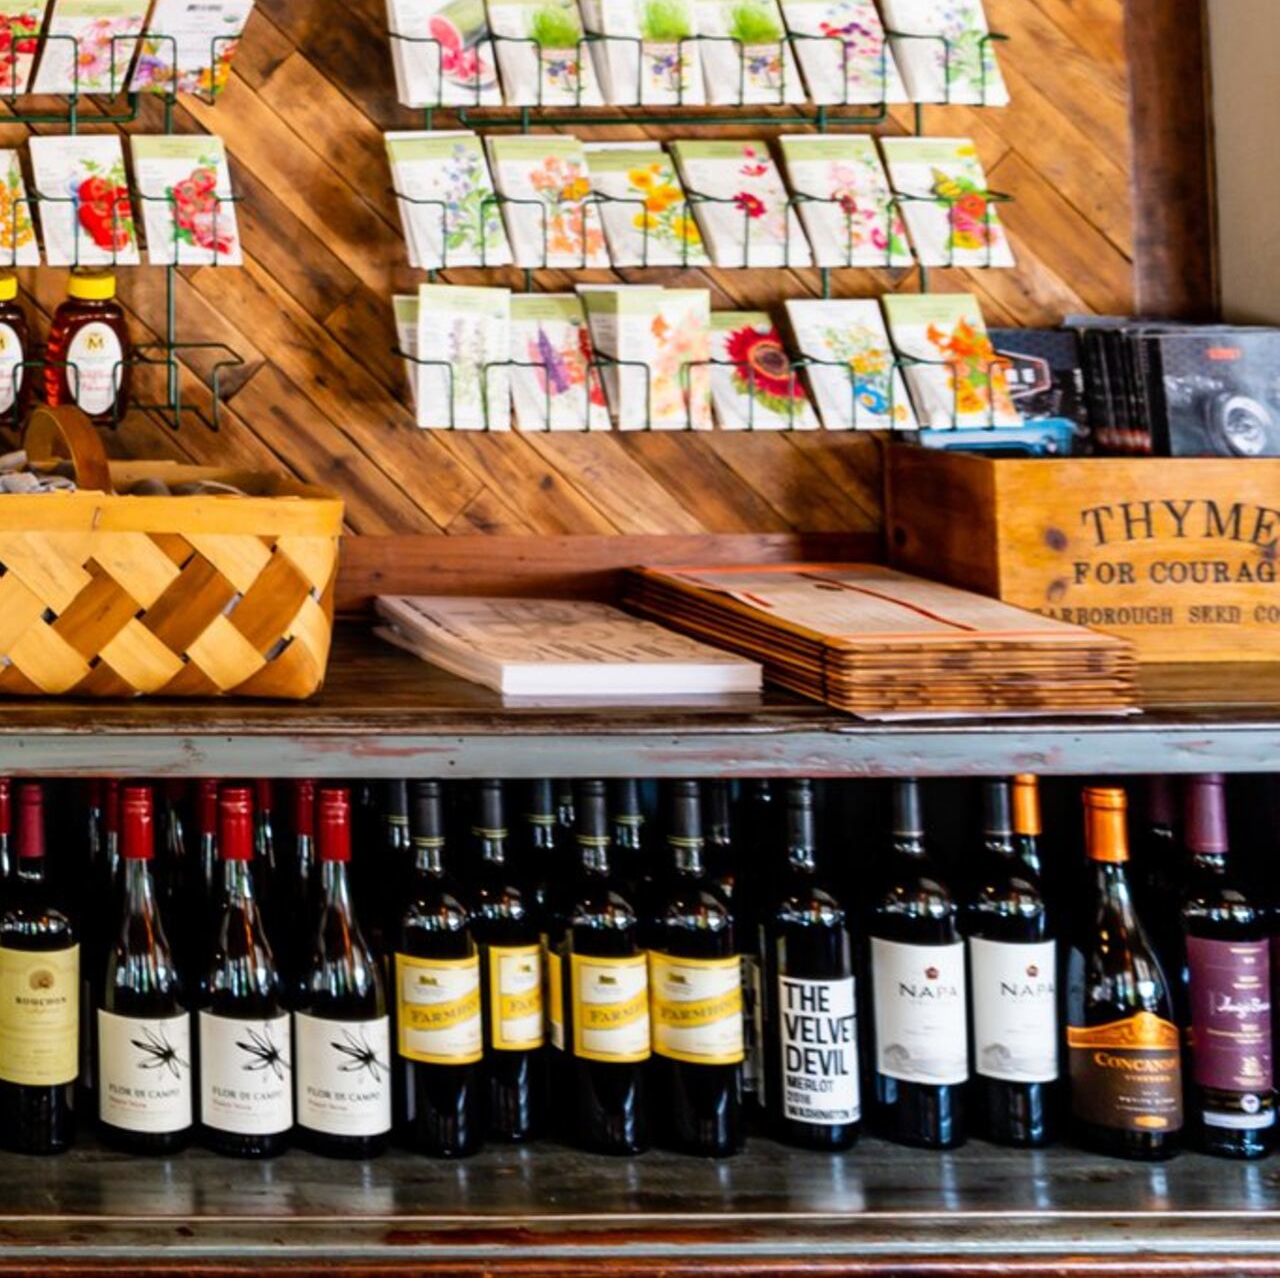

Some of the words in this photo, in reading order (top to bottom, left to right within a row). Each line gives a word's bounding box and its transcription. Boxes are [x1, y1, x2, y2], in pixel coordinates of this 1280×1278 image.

[1081, 499, 1280, 549] THYME
[1073, 562, 1136, 584] FOR
[1149, 561, 1276, 584] COURAG
[1038, 607, 1173, 625] ARBOROUGH
[1189, 606, 1241, 624] SEED
[782, 981, 830, 1012] THE
[898, 982, 957, 999] NAPA
[786, 1044, 849, 1076] DEVIL
[786, 1075, 834, 1092] MERLOT
